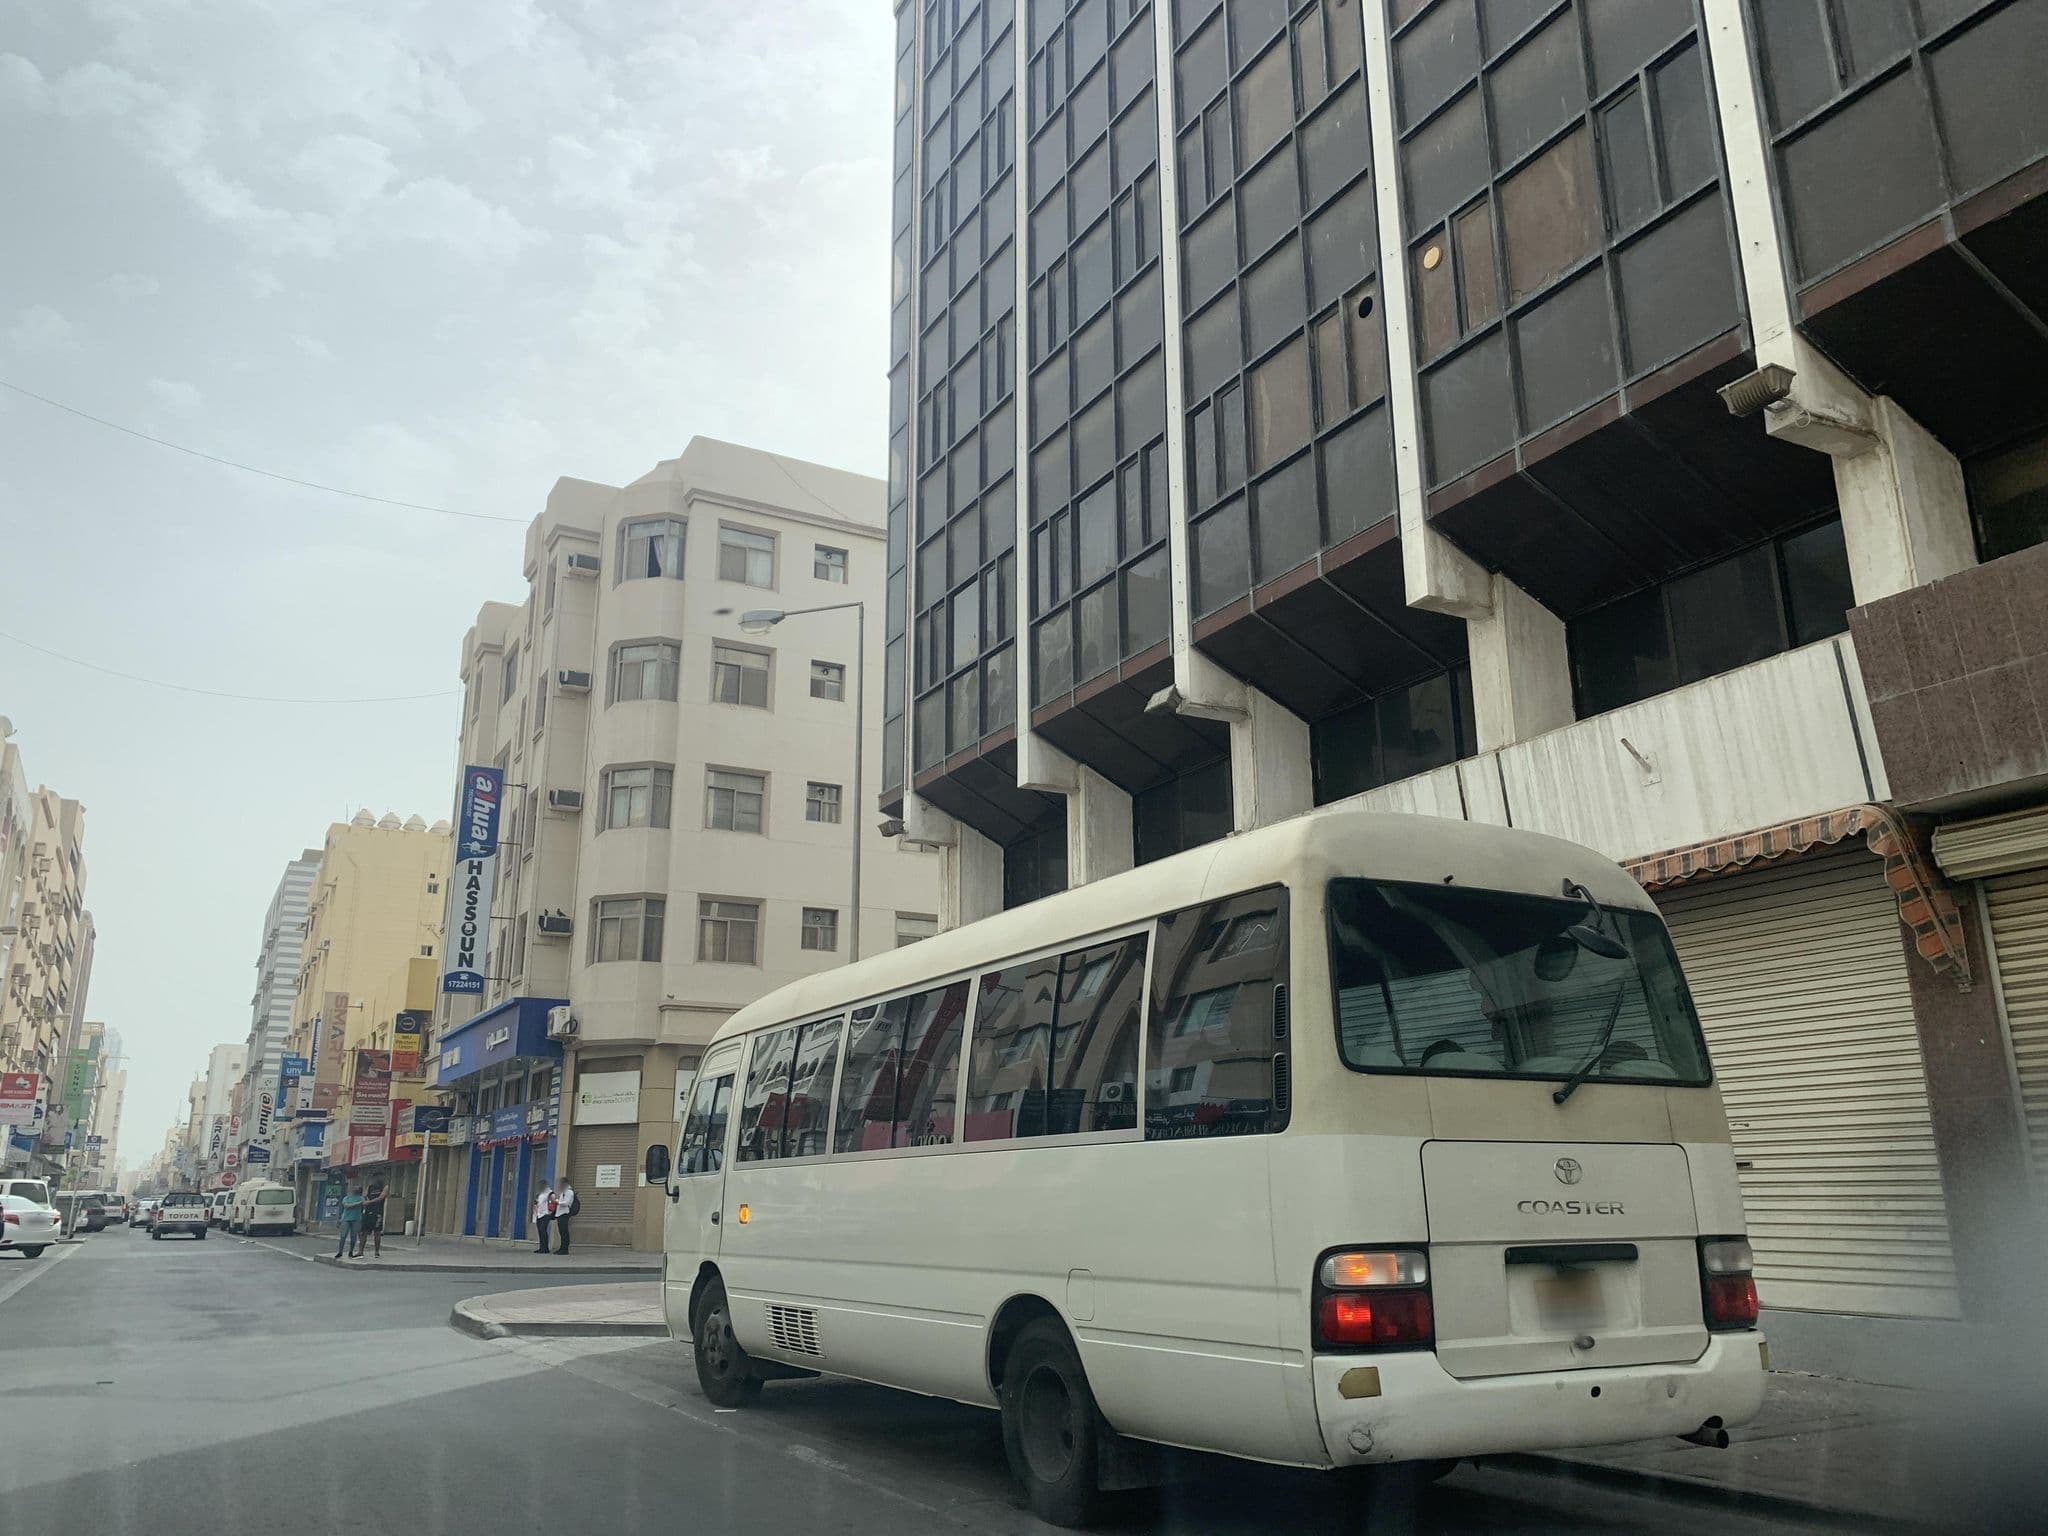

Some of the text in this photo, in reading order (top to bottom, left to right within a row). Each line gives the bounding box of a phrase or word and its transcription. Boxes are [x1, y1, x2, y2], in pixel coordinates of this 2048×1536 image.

[458, 860, 482, 969] HASSOUN
[447, 980, 481, 989] 17224151
[328, 993, 349, 1066] SMART
[1517, 1200, 1625, 1215] COASTER
